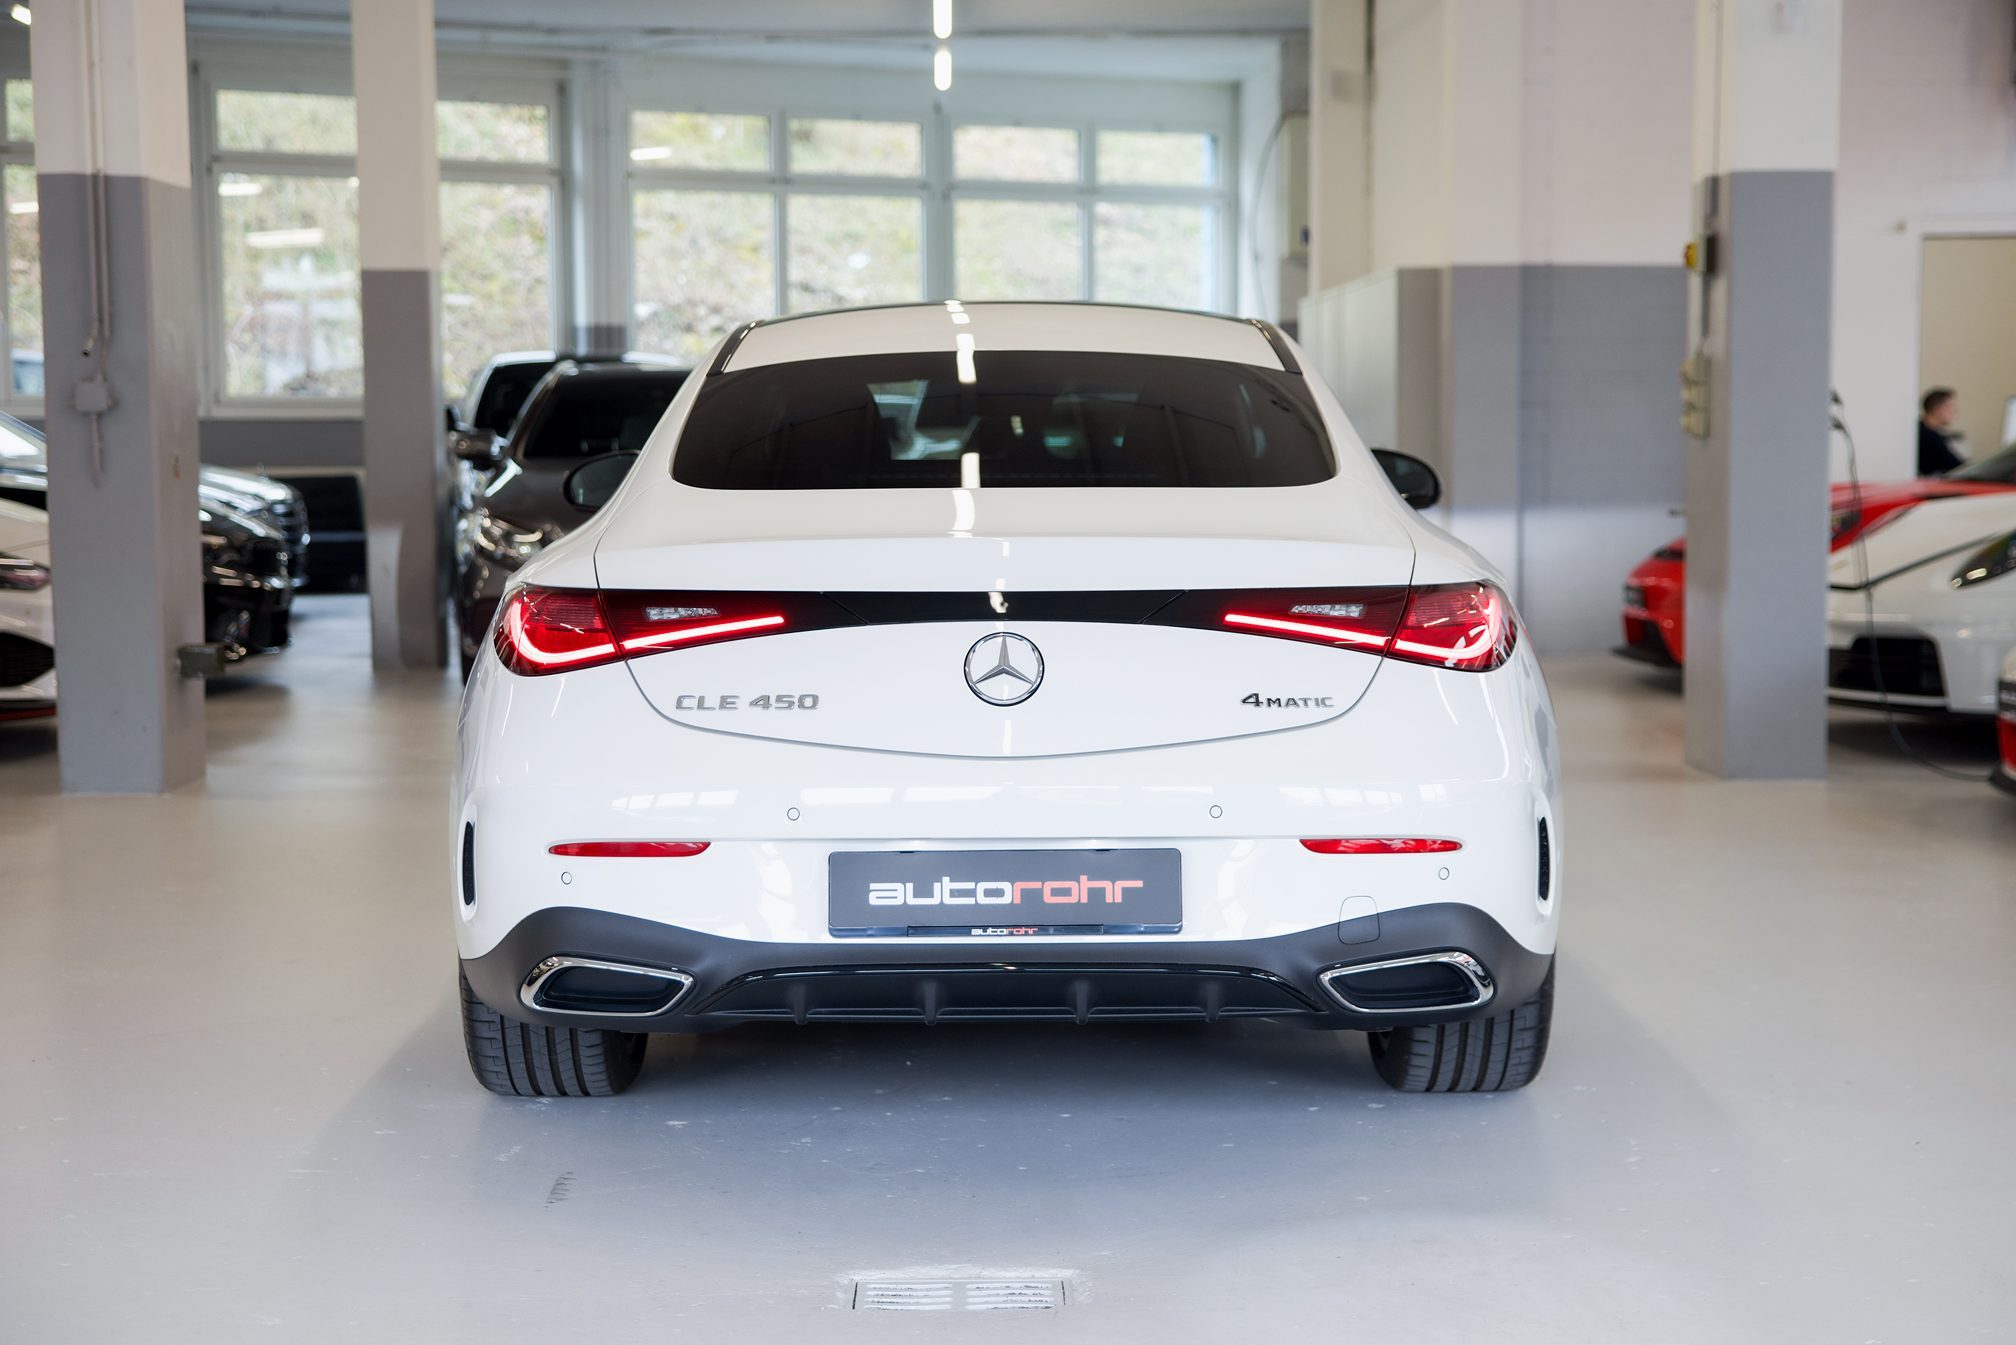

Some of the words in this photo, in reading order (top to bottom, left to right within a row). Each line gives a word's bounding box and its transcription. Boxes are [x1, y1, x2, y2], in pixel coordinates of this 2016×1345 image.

[675, 694, 740, 711] CLE
[749, 693, 820, 711] 450
[1240, 692, 1335, 708] 4MATIC
[868, 875, 1144, 906] autorohr
[970, 926, 1039, 936] autorohr
